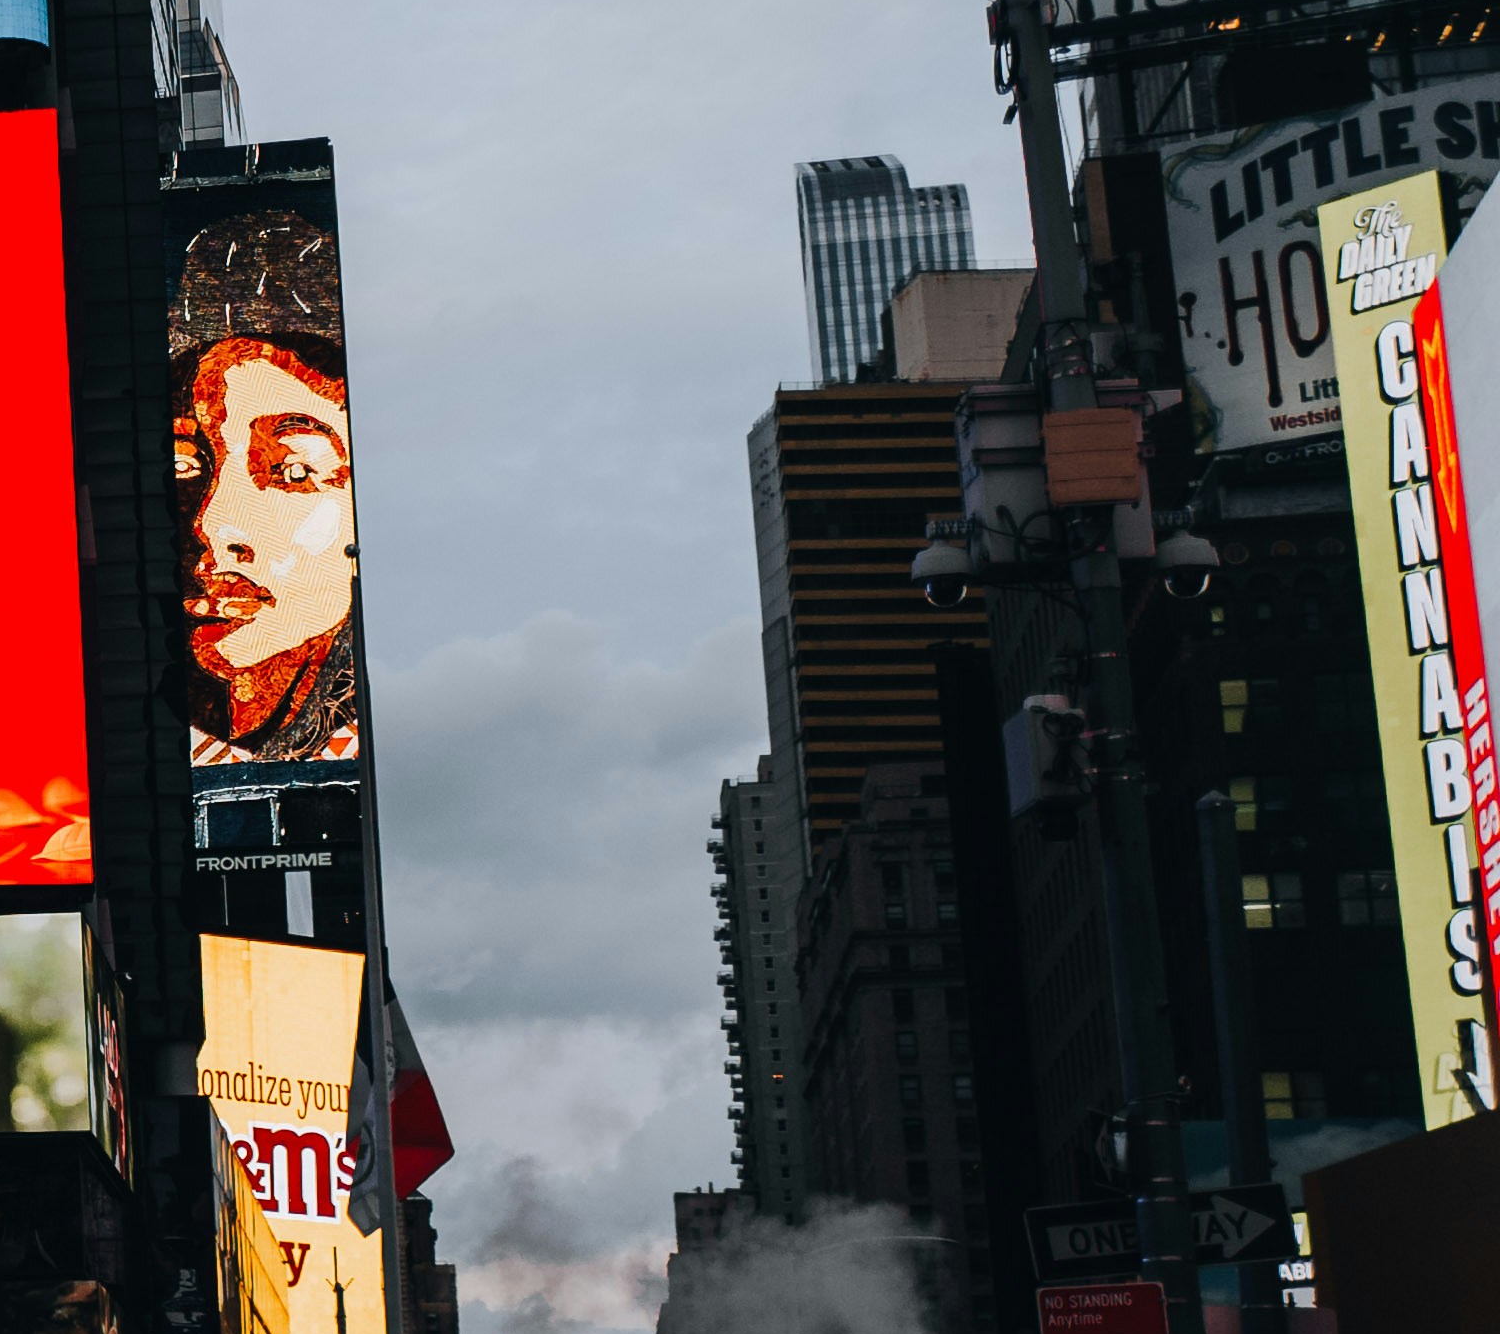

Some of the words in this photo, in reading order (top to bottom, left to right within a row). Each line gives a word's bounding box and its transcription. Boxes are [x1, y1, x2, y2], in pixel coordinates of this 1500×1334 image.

[1210, 105, 1421, 244] LITTLE
[1354, 200, 1404, 240] The
[1338, 225, 1414, 282] DAILY
[1353, 253, 1437, 315] GREEN
[1268, 405, 1342, 432] Westsid
[1376, 319, 1484, 997] CANNABIS
[195, 852, 333, 873] FRONTPRIME
[1067, 1218, 1140, 1256] ONE
[1044, 1296, 1064, 1310] NO
[1067, 1292, 1134, 1309] STANDING
[1047, 1312, 1104, 1329] Anytime
